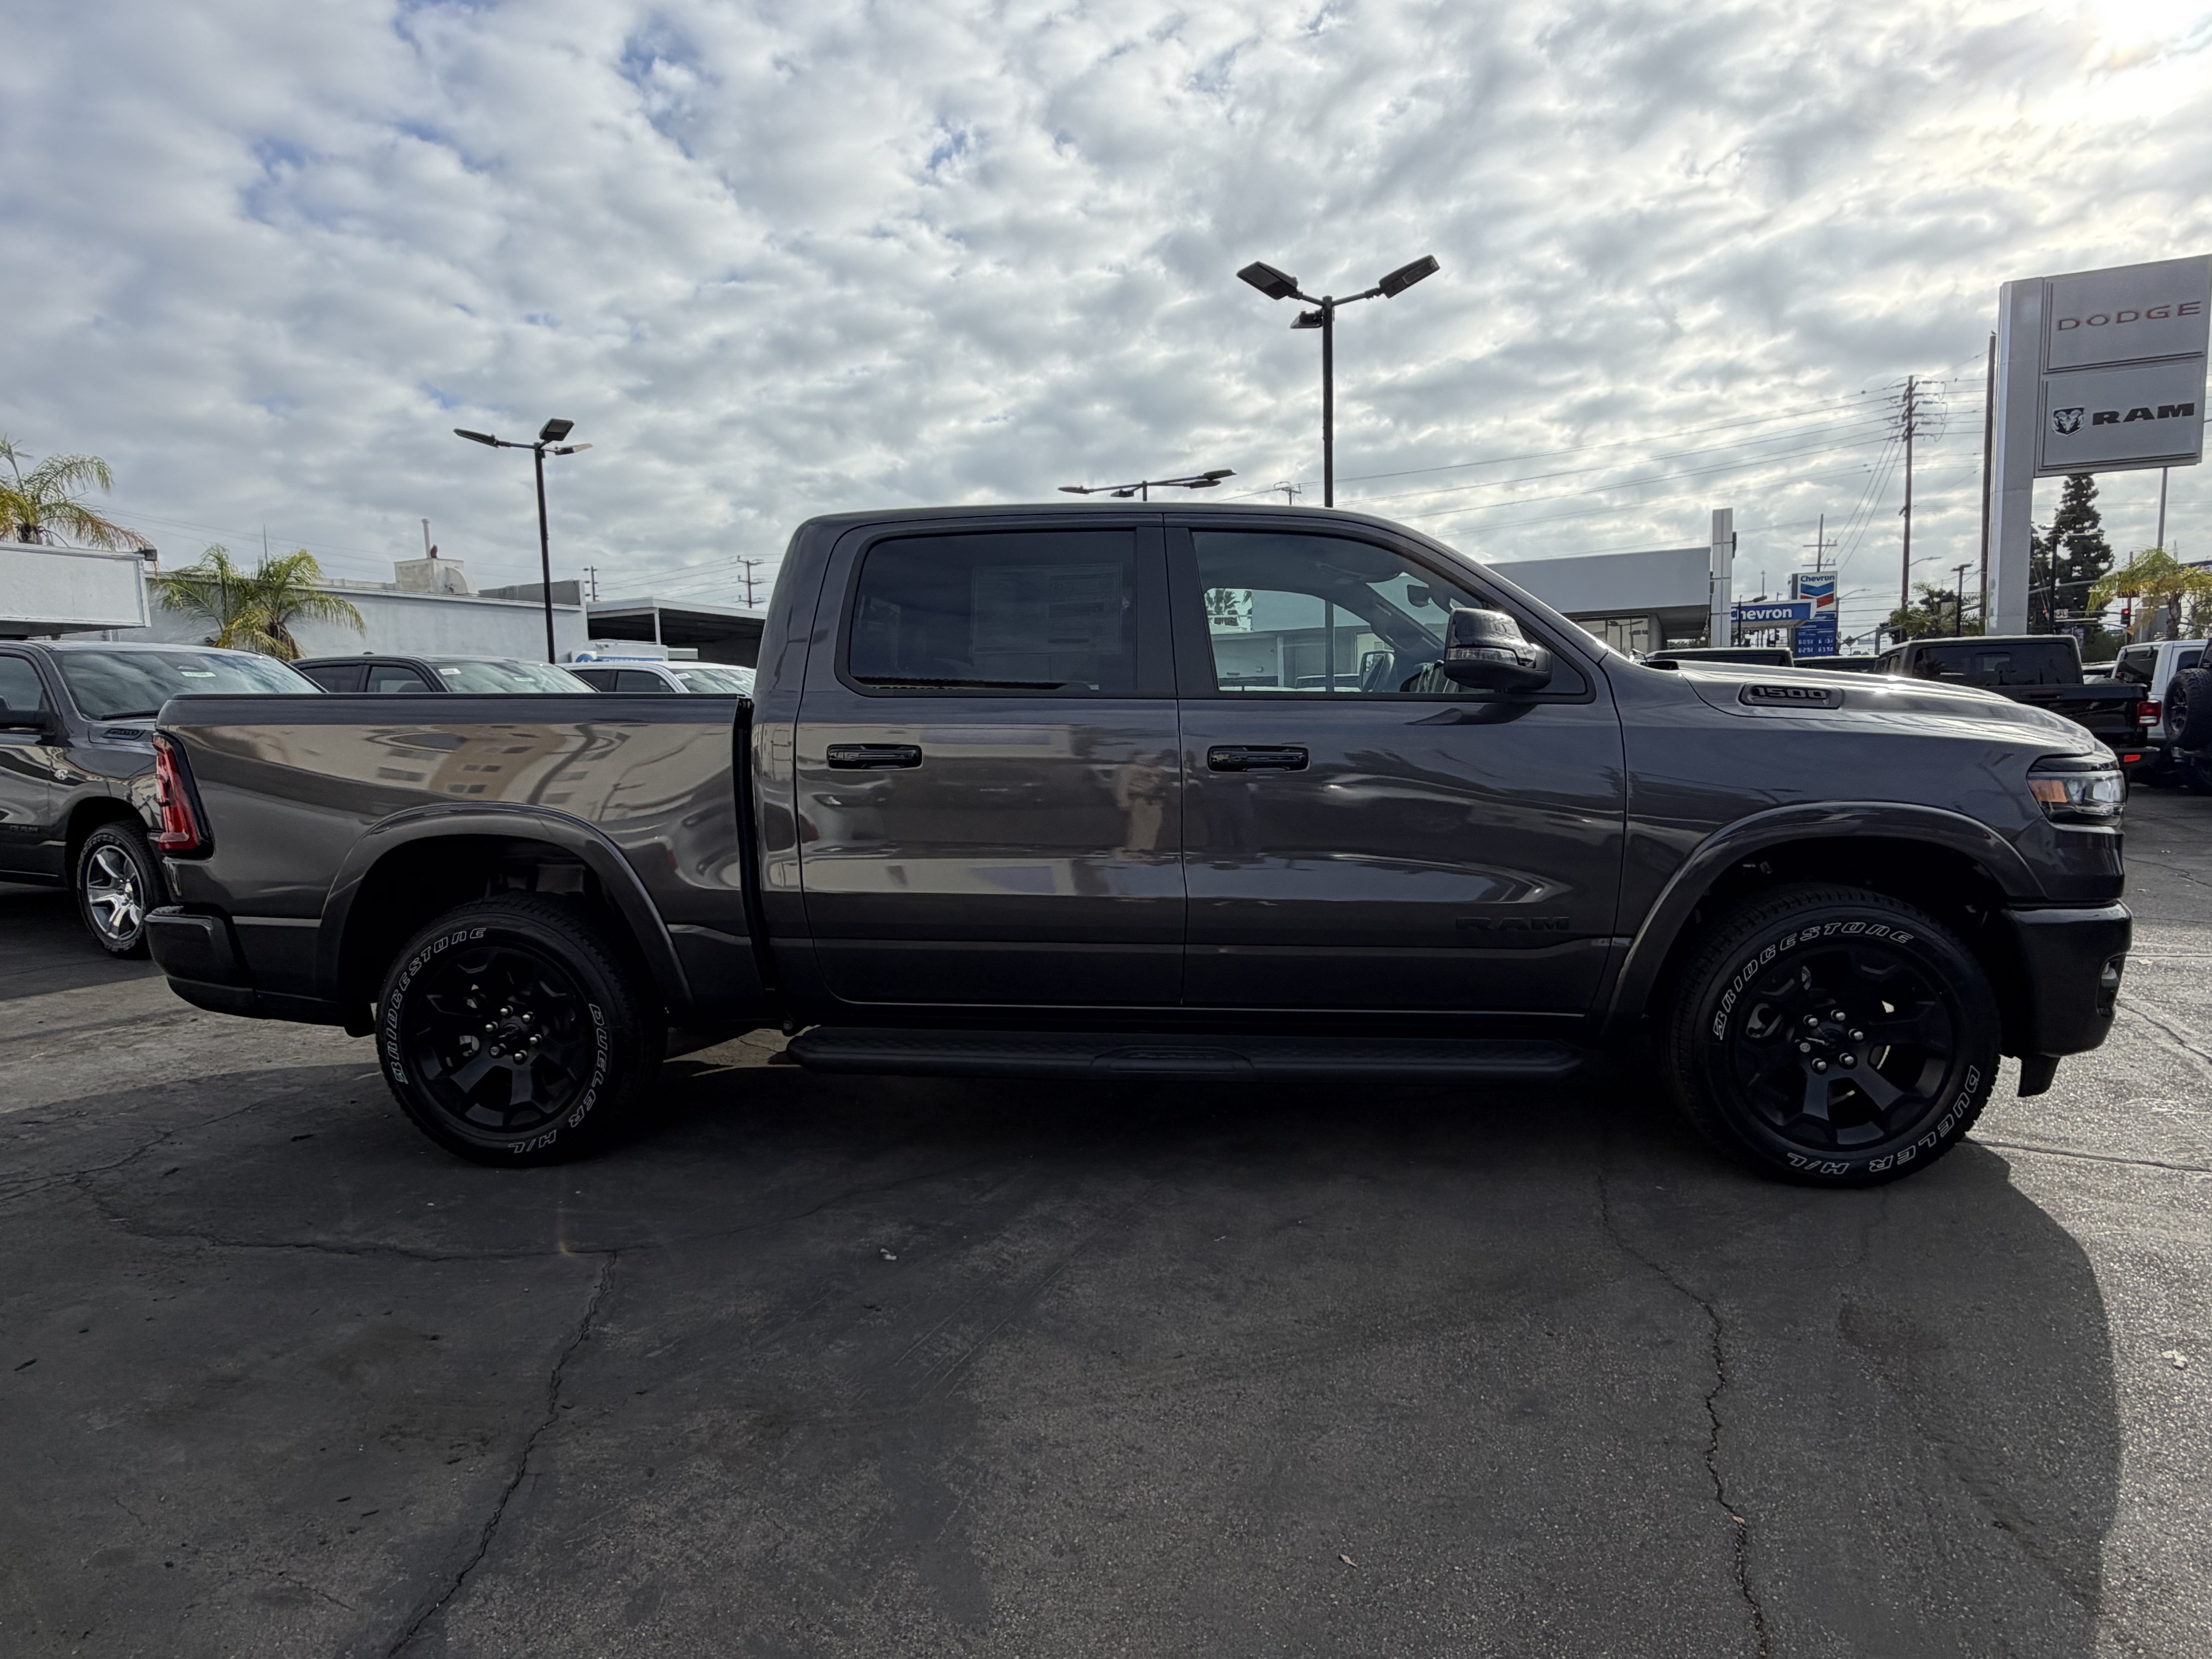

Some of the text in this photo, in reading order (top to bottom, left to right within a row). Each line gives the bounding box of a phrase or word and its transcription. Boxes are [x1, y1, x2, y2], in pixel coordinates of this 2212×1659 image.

[2057, 301, 2201, 331] DODGE
[2092, 403, 2195, 426] RAM
[1753, 687, 1827, 698] 1500
[1456, 916, 1570, 930] RAM
[386, 927, 486, 1084] BRIDGESTONE
[1712, 922, 1915, 1040] BRIDGESTONE
[508, 1003, 608, 1153] DUELER H/L
[1787, 1065, 1981, 1175] DUELER H/L
